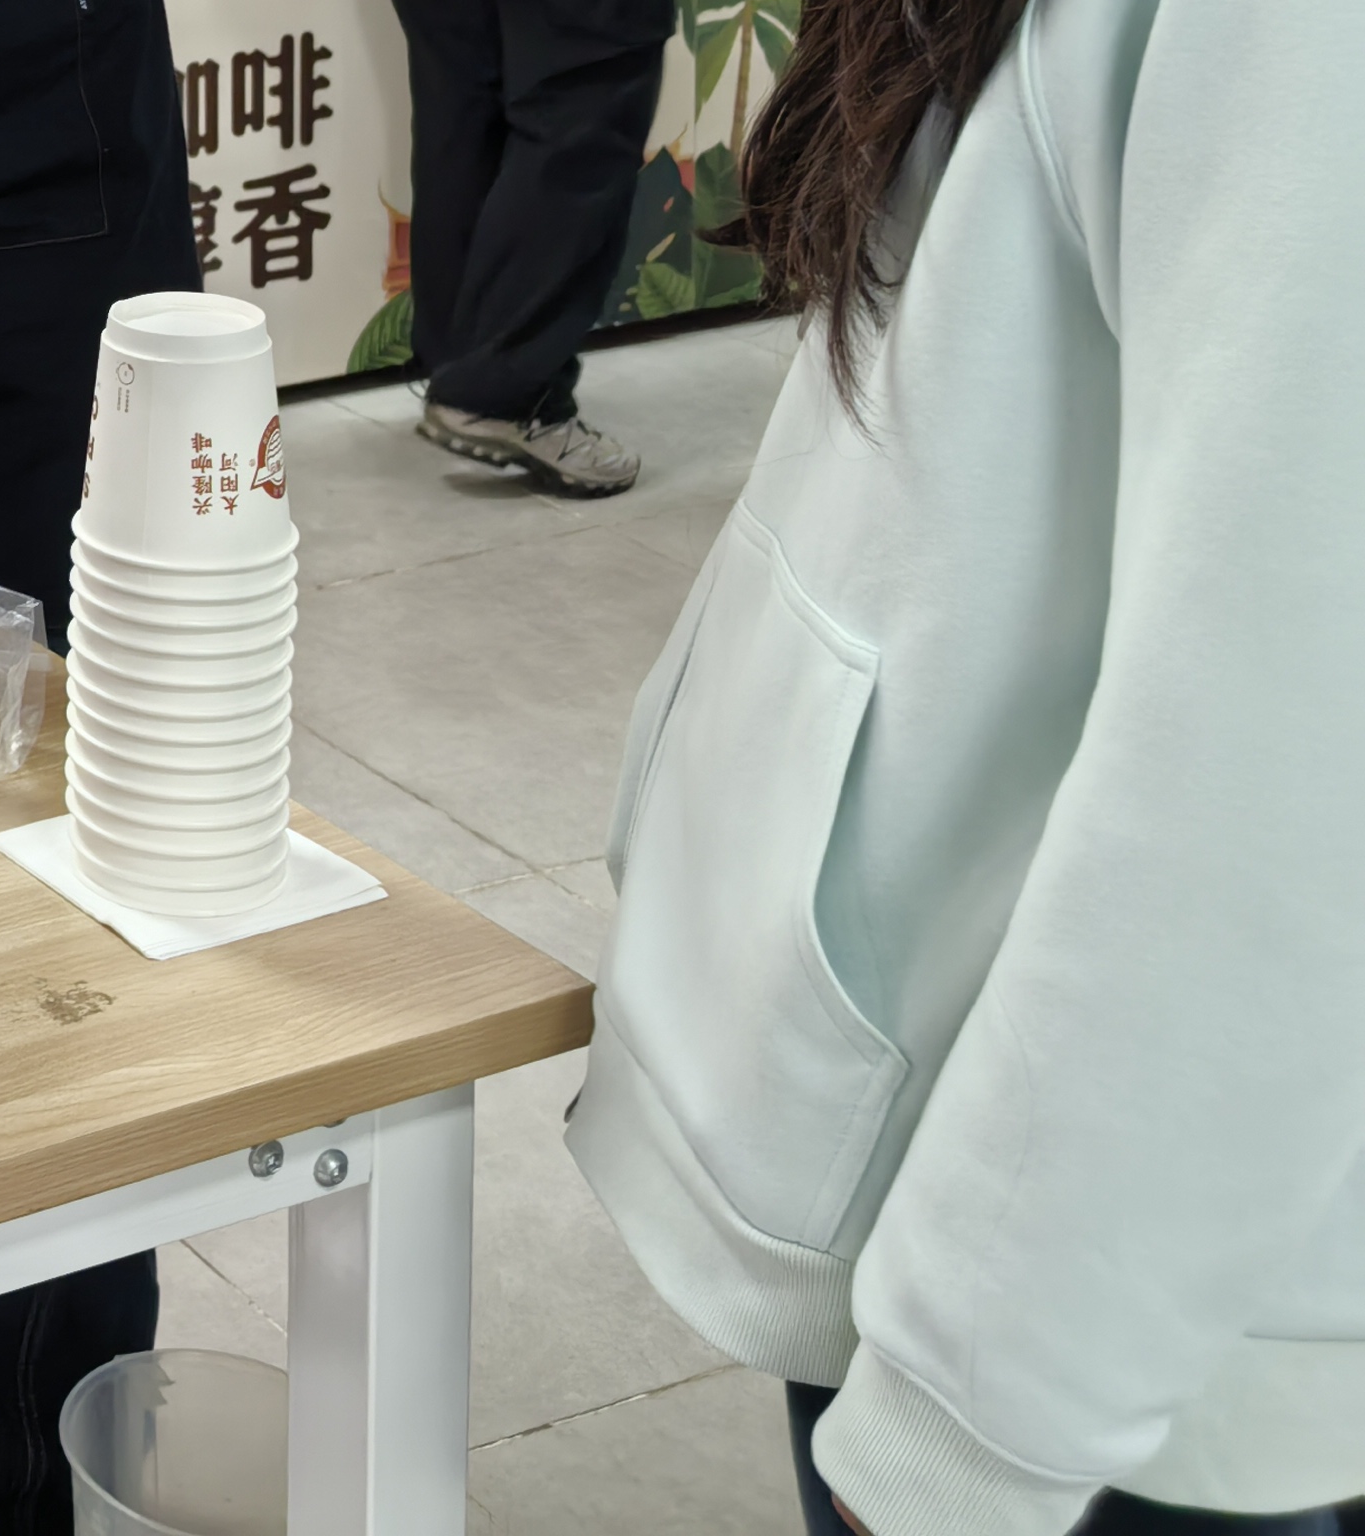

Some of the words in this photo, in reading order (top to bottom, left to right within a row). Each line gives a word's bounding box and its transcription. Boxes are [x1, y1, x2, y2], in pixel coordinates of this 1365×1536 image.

[191, 432, 213, 515] 兴隆咖啡
[219, 452, 240, 515] 太阳河
